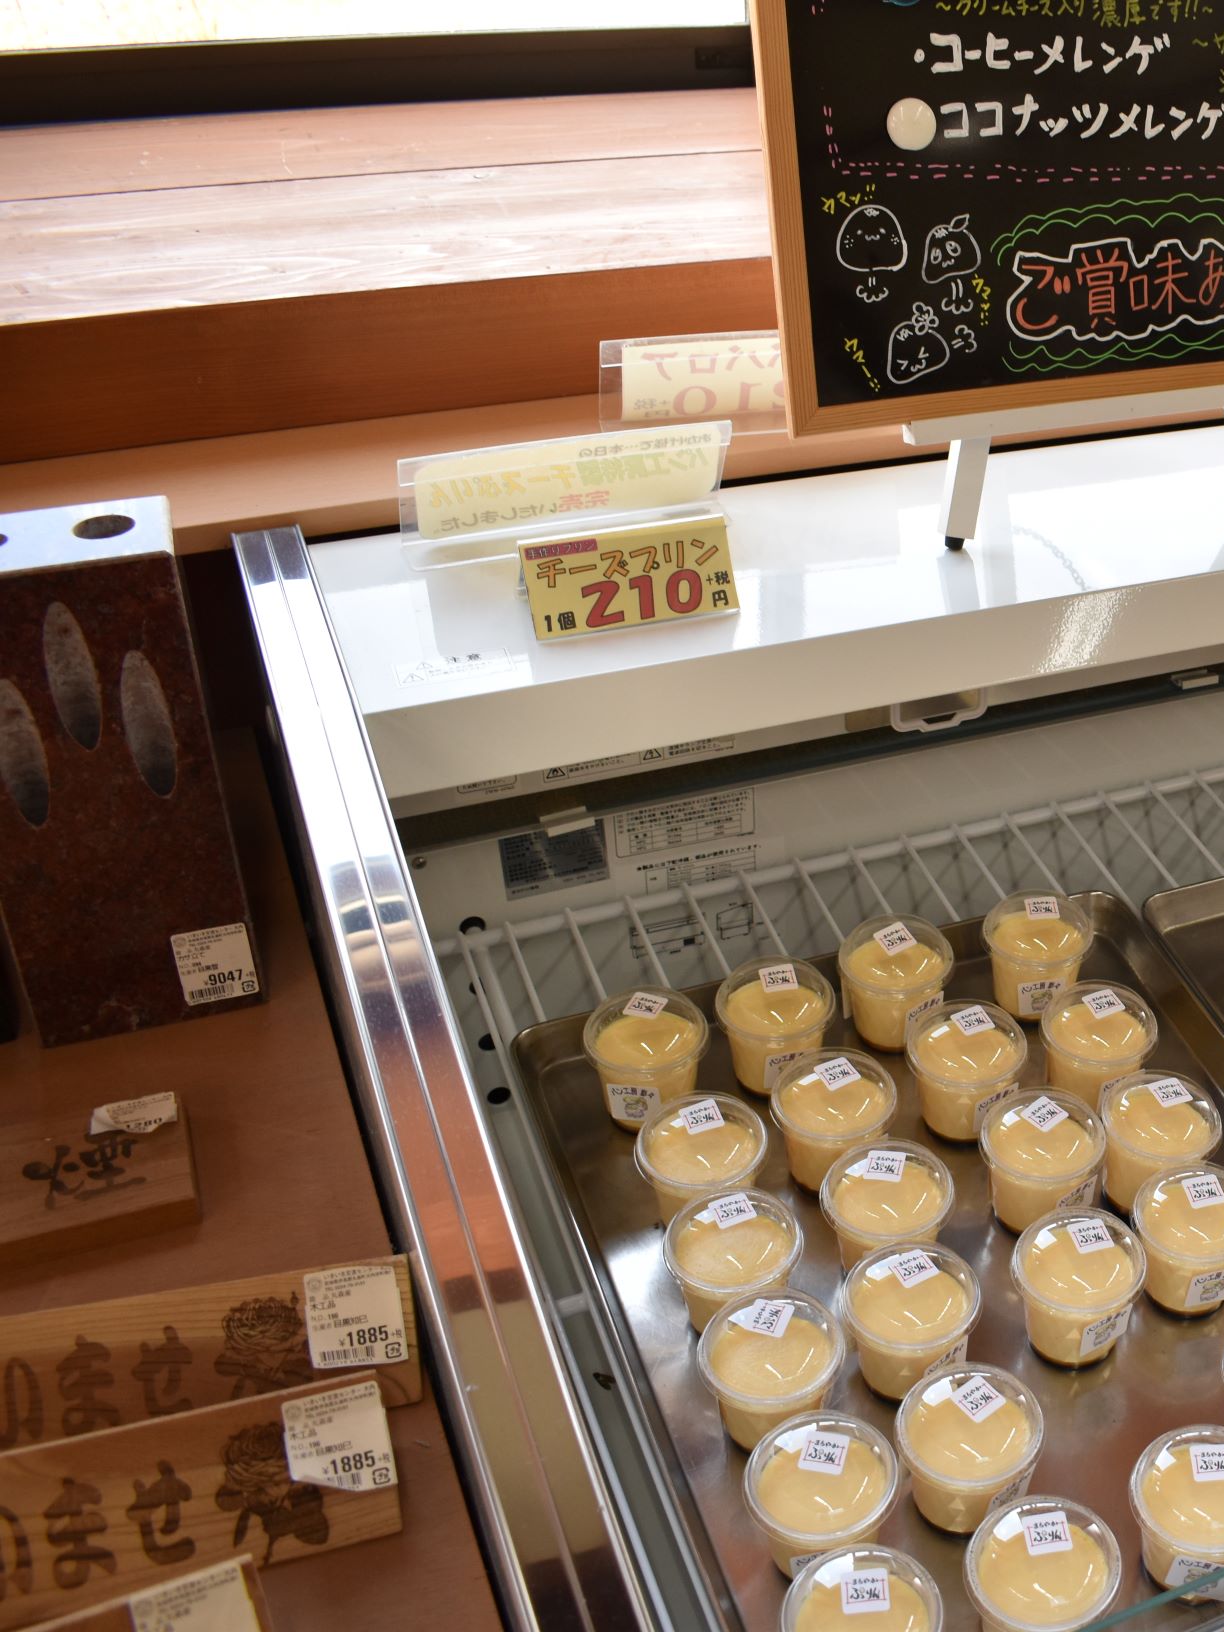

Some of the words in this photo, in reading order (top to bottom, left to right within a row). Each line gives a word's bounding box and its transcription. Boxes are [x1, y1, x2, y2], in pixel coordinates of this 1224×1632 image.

[536, 538, 719, 588] チーズプリン
[581, 568, 703, 629] 210
